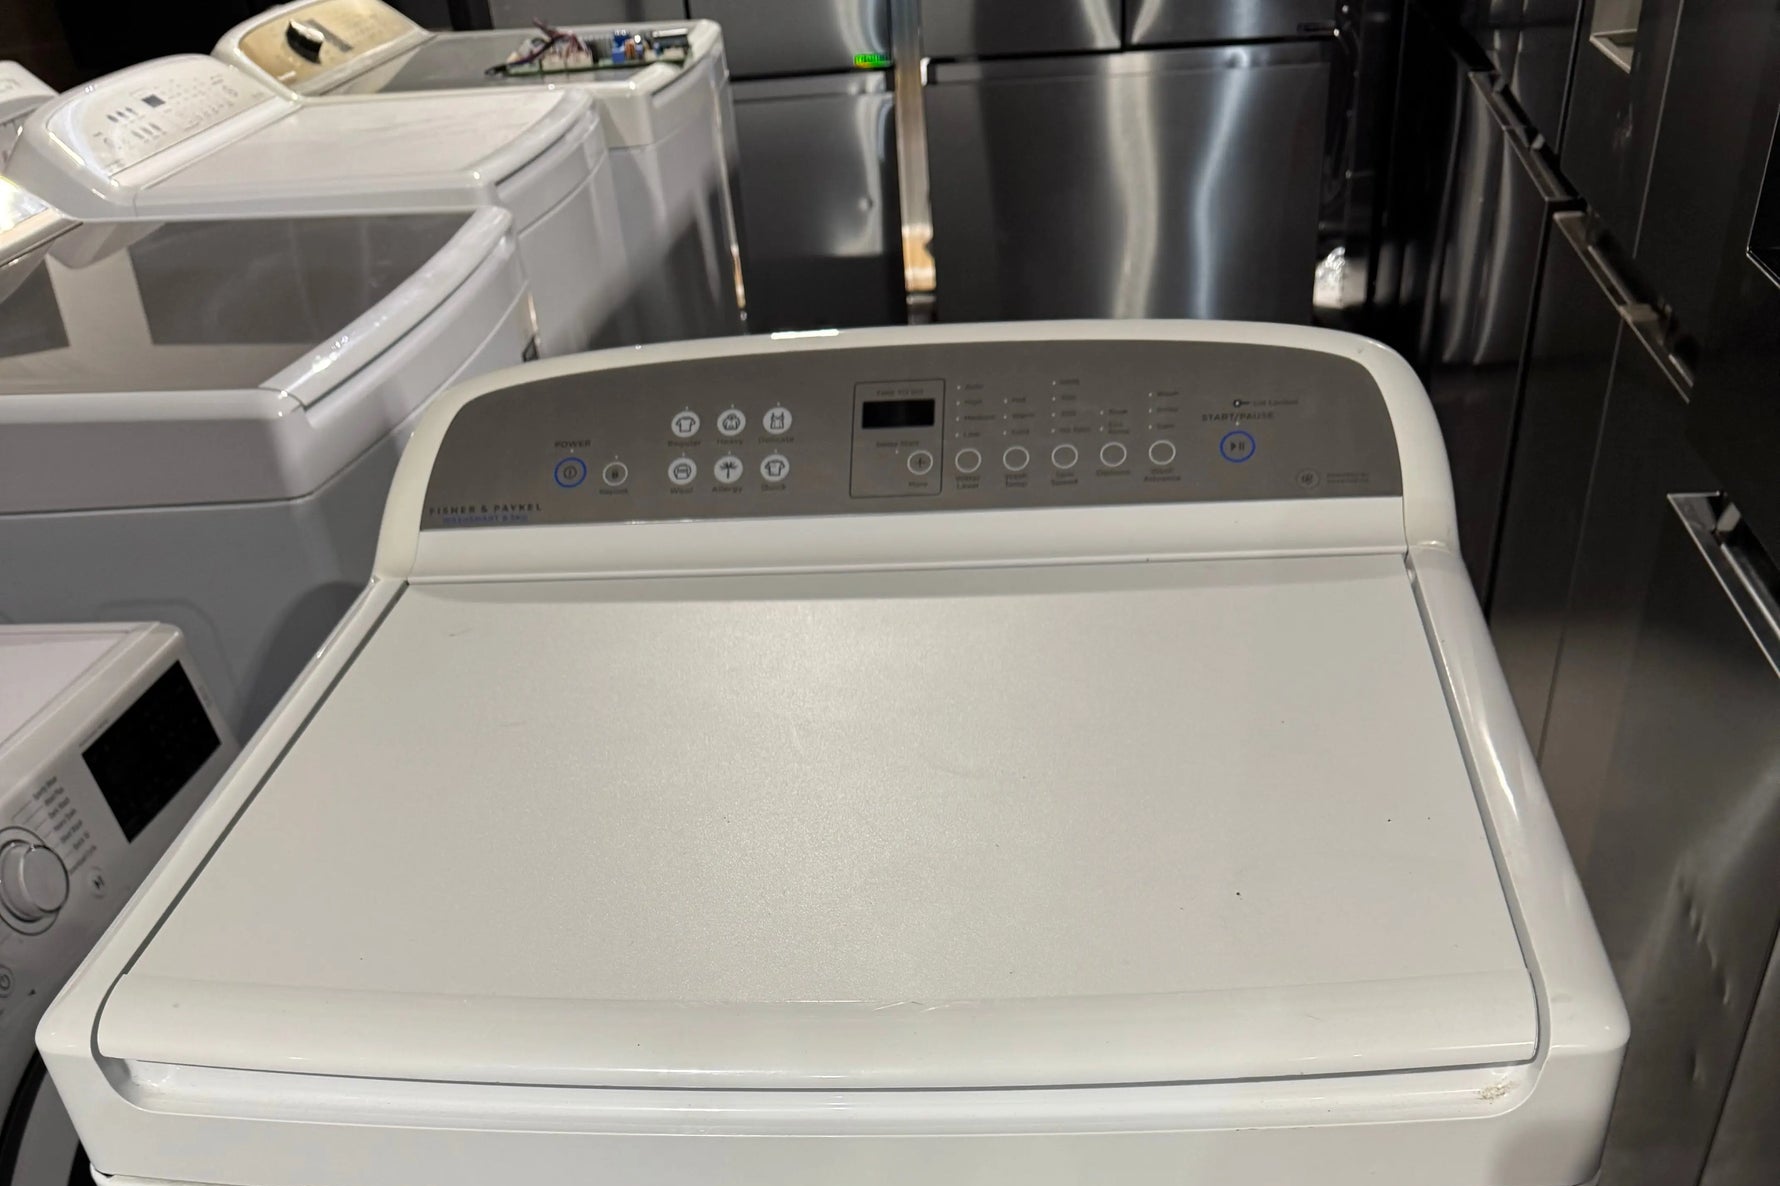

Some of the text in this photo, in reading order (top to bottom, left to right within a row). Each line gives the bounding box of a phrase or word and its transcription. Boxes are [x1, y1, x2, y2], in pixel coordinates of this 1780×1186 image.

[554, 439, 591, 448] POWER
[429, 505, 475, 516] FISHER
[494, 503, 542, 513] PAYKEL
